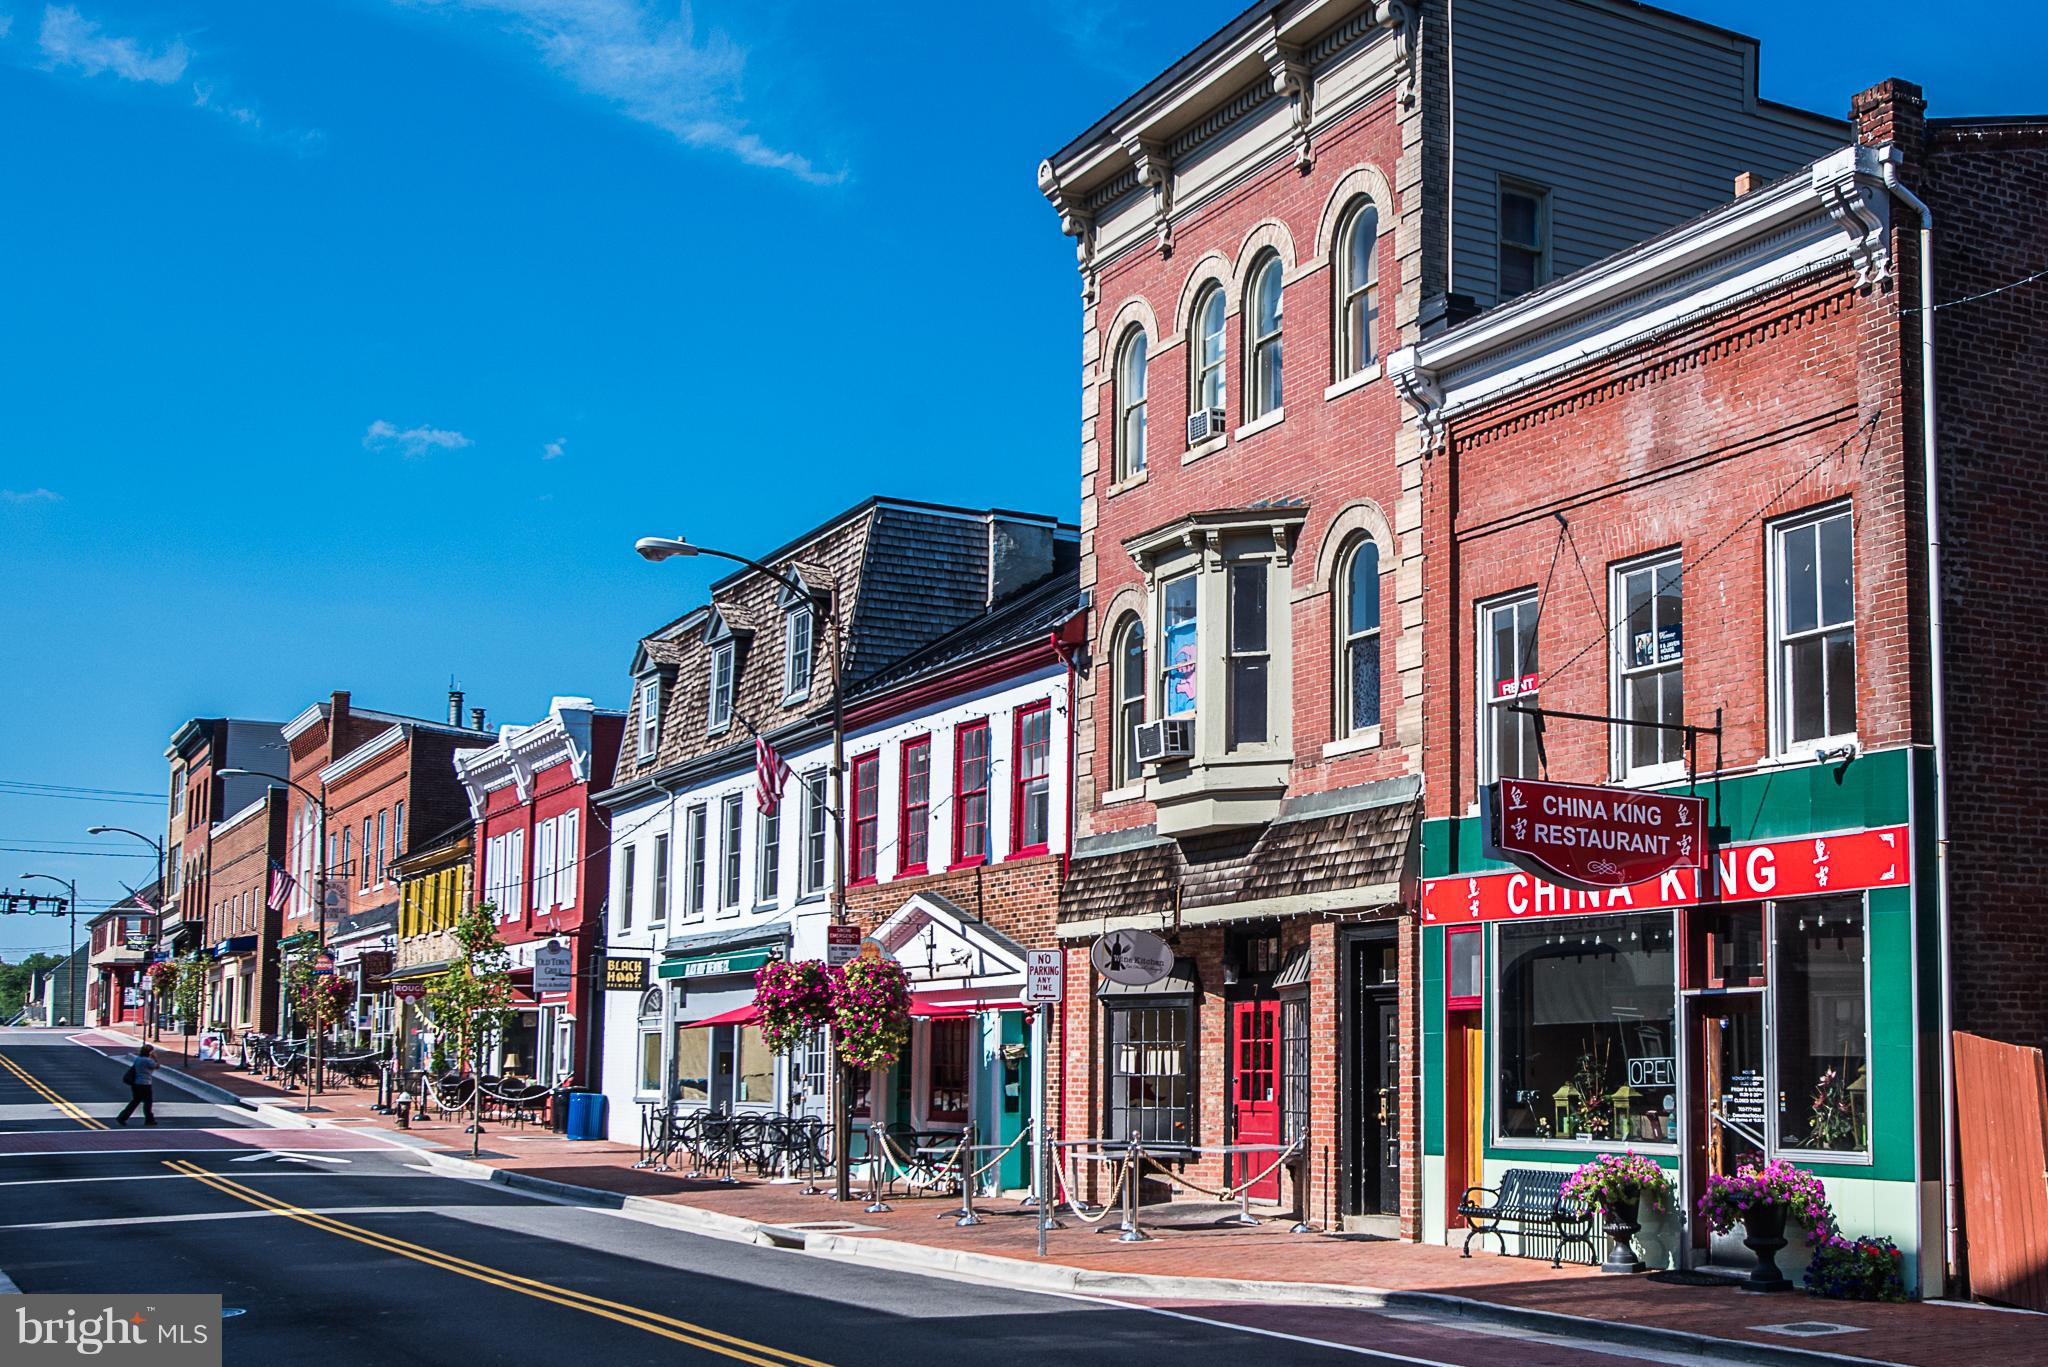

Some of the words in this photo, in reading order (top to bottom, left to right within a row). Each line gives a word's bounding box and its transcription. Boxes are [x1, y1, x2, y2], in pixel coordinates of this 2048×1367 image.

[1502, 678, 1534, 695] RENT
[1542, 795, 1608, 821] CHINA
[1613, 802, 1662, 826] KING
[1534, 823, 1671, 856] RESTAURANT
[1660, 846, 1777, 902] KING
[607, 960, 642, 971] BLACK
[1038, 954, 1052, 965] NO
[1134, 956, 1165, 967] Kitchen
[607, 971, 642, 983] HOOF
[1029, 966, 1060, 976] PARKING
[1631, 1060, 1677, 1084] OPEN
